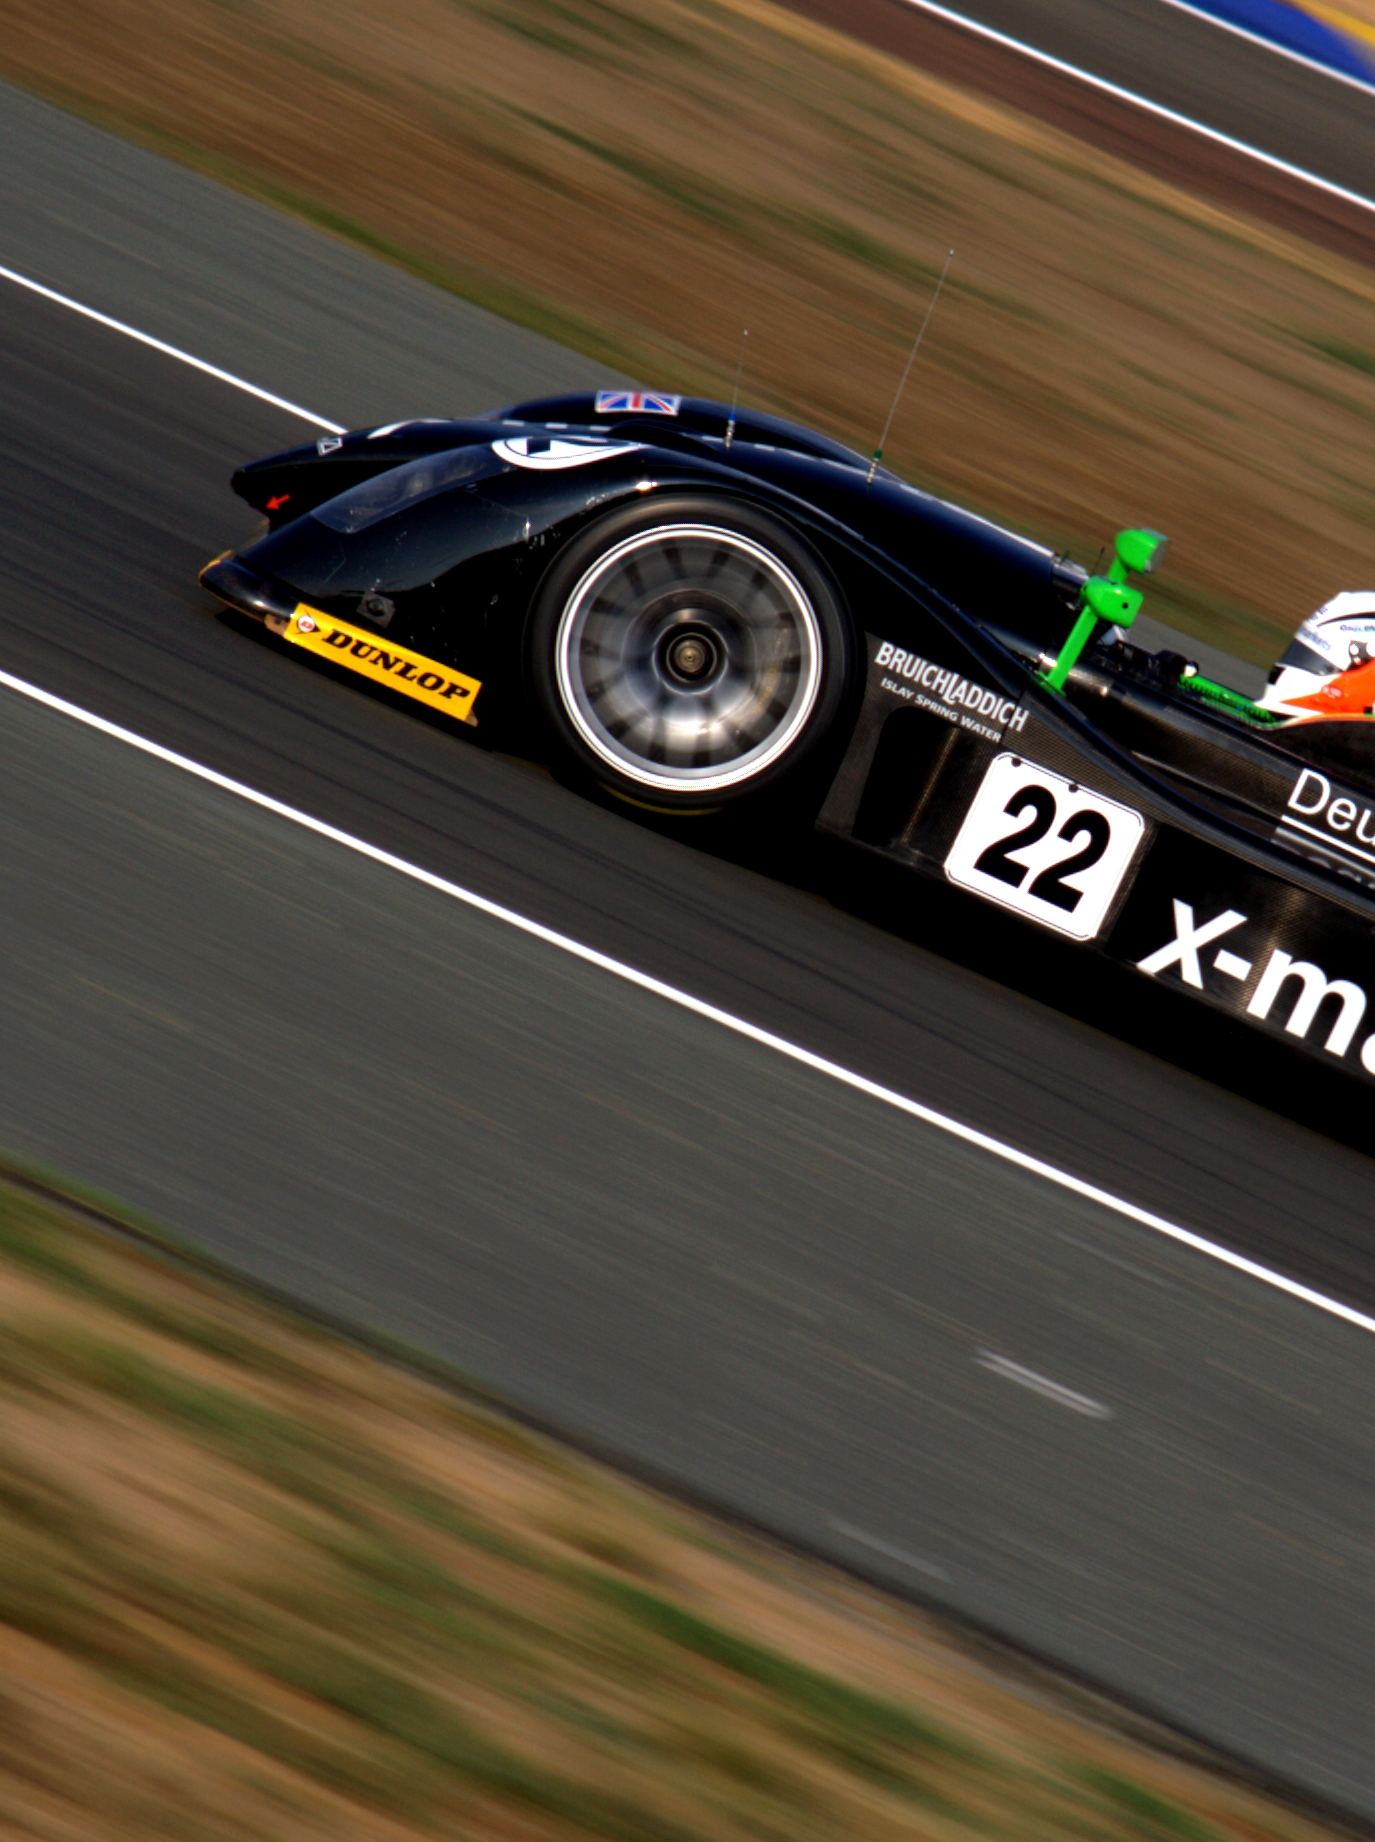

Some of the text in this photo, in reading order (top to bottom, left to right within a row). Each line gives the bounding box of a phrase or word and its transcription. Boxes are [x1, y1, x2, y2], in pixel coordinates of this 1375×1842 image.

[321, 628, 471, 699] DUNLOP
[875, 641, 1029, 732] BRUICHLADDICH
[880, 677, 1002, 743] ISLAY SPRING WATER
[974, 784, 1112, 914] 22
